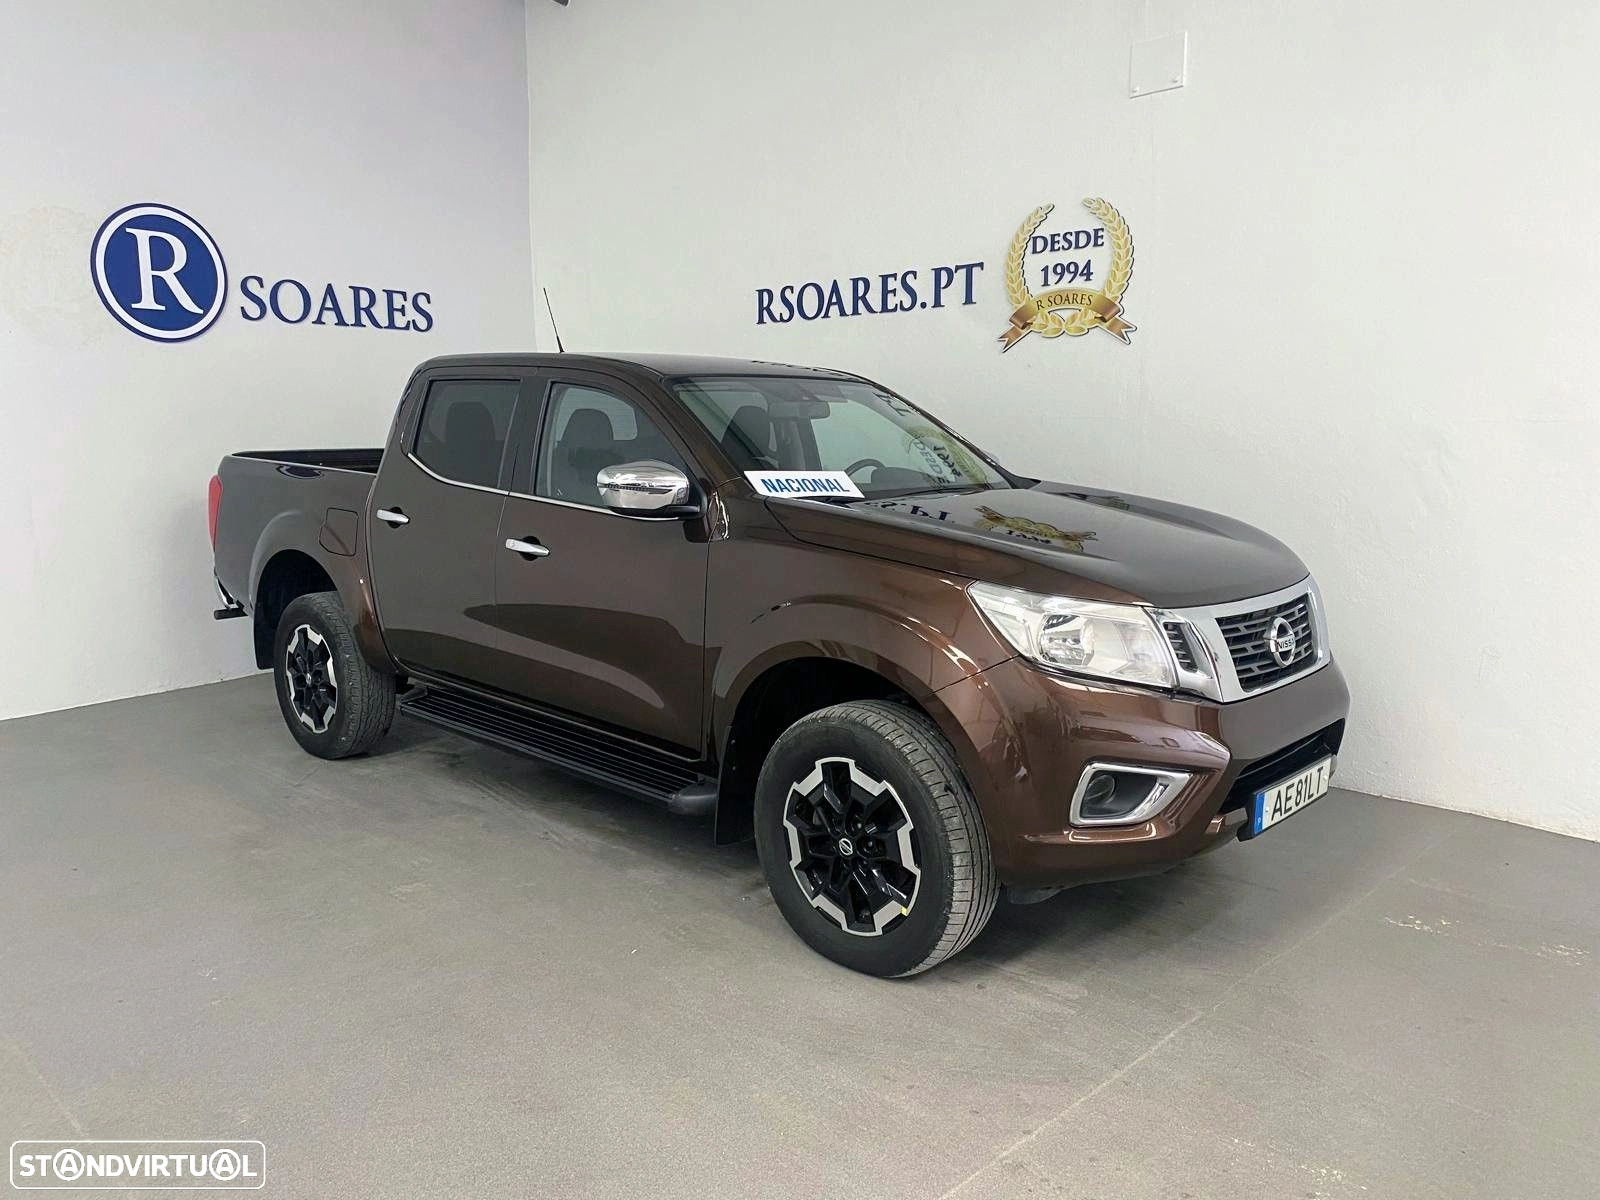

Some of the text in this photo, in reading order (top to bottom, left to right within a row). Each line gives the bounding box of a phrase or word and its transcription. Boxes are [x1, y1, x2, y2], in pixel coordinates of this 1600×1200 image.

[1031, 227, 1105, 255] DESDE
[125, 226, 434, 333] R SOARES
[1040, 258, 1094, 287] 1994
[755, 261, 985, 325] RSOARES.PT
[1036, 292, 1094, 311] R SOARES
[760, 478, 851, 493] NACIONAL
[1270, 765, 1324, 822] AE81LT
